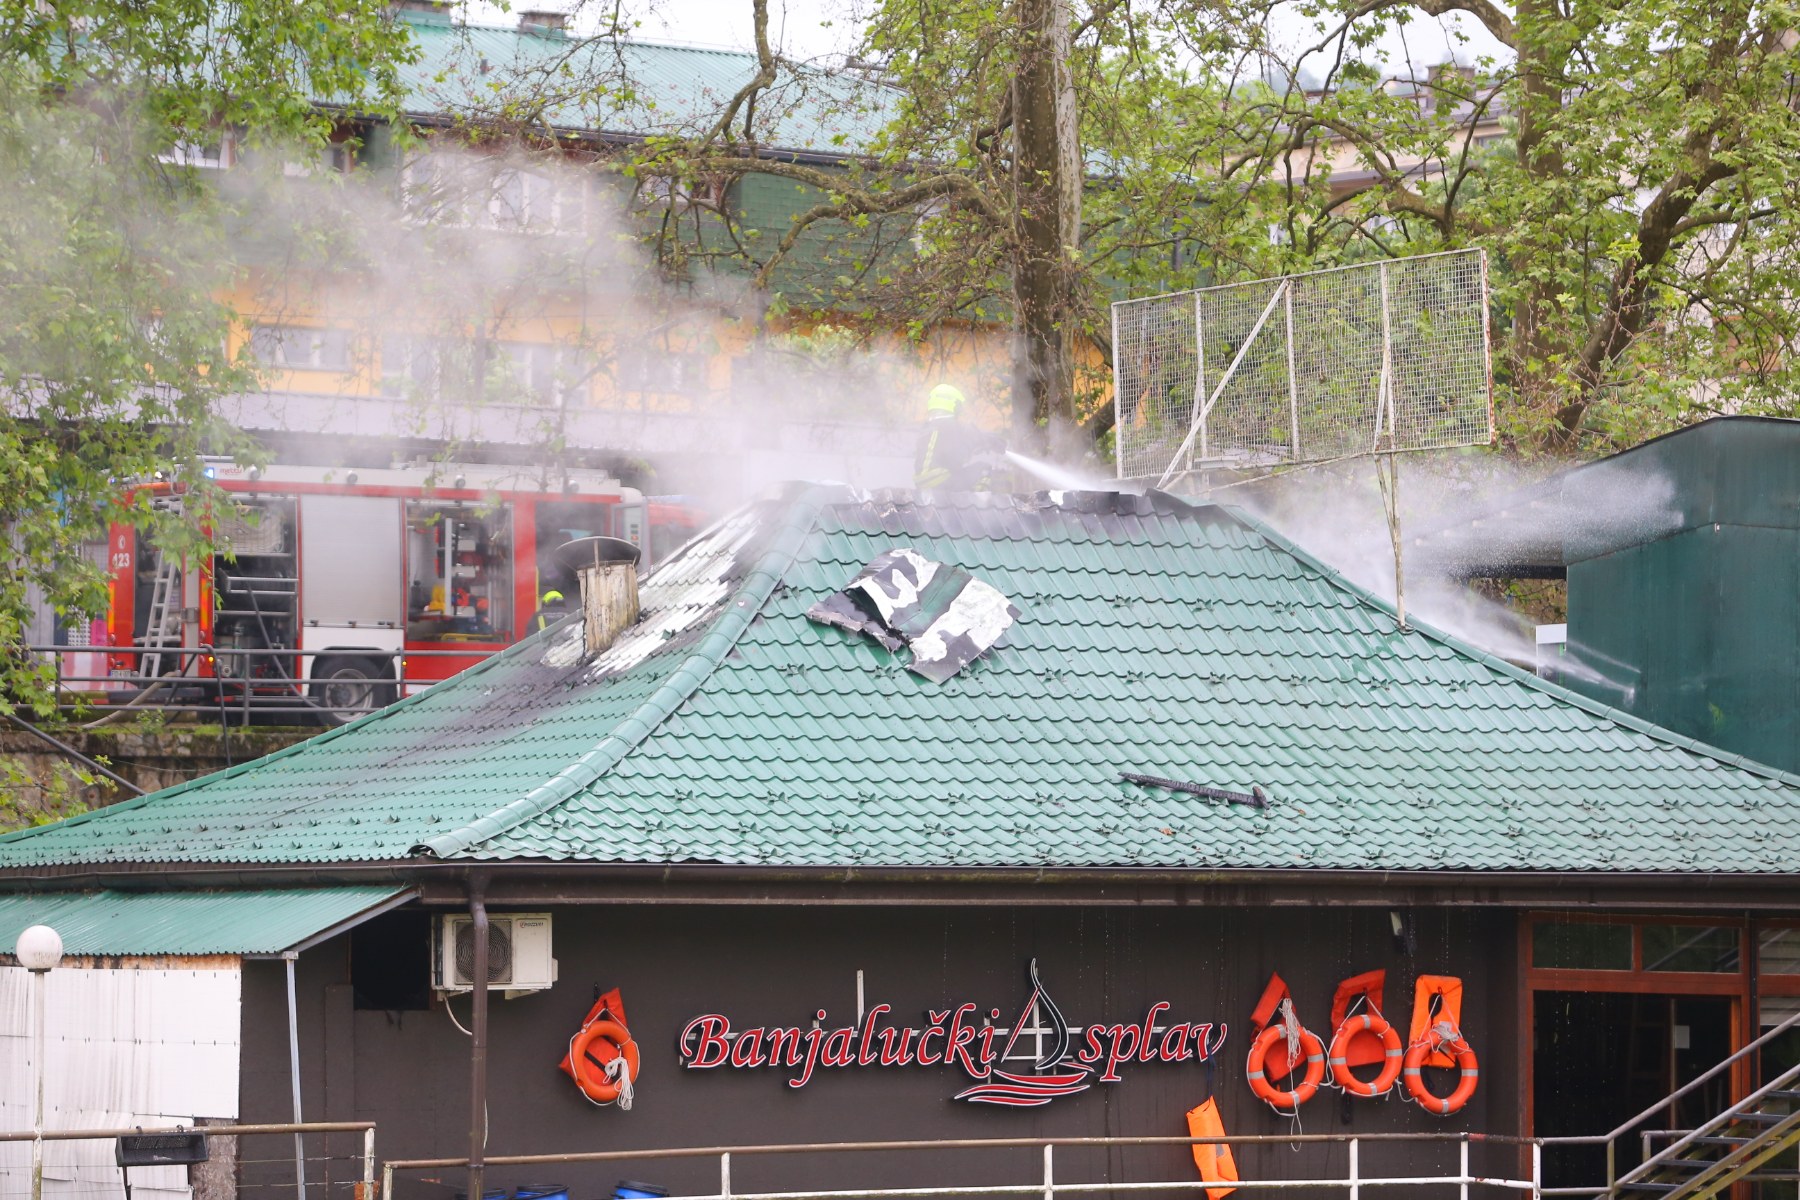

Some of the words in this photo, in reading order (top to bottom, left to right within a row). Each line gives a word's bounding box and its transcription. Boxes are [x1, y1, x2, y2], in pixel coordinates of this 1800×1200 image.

[112, 552, 130, 567] 123
[680, 1003, 999, 1088] Banjalučki
[1078, 1001, 1228, 1082] splav
